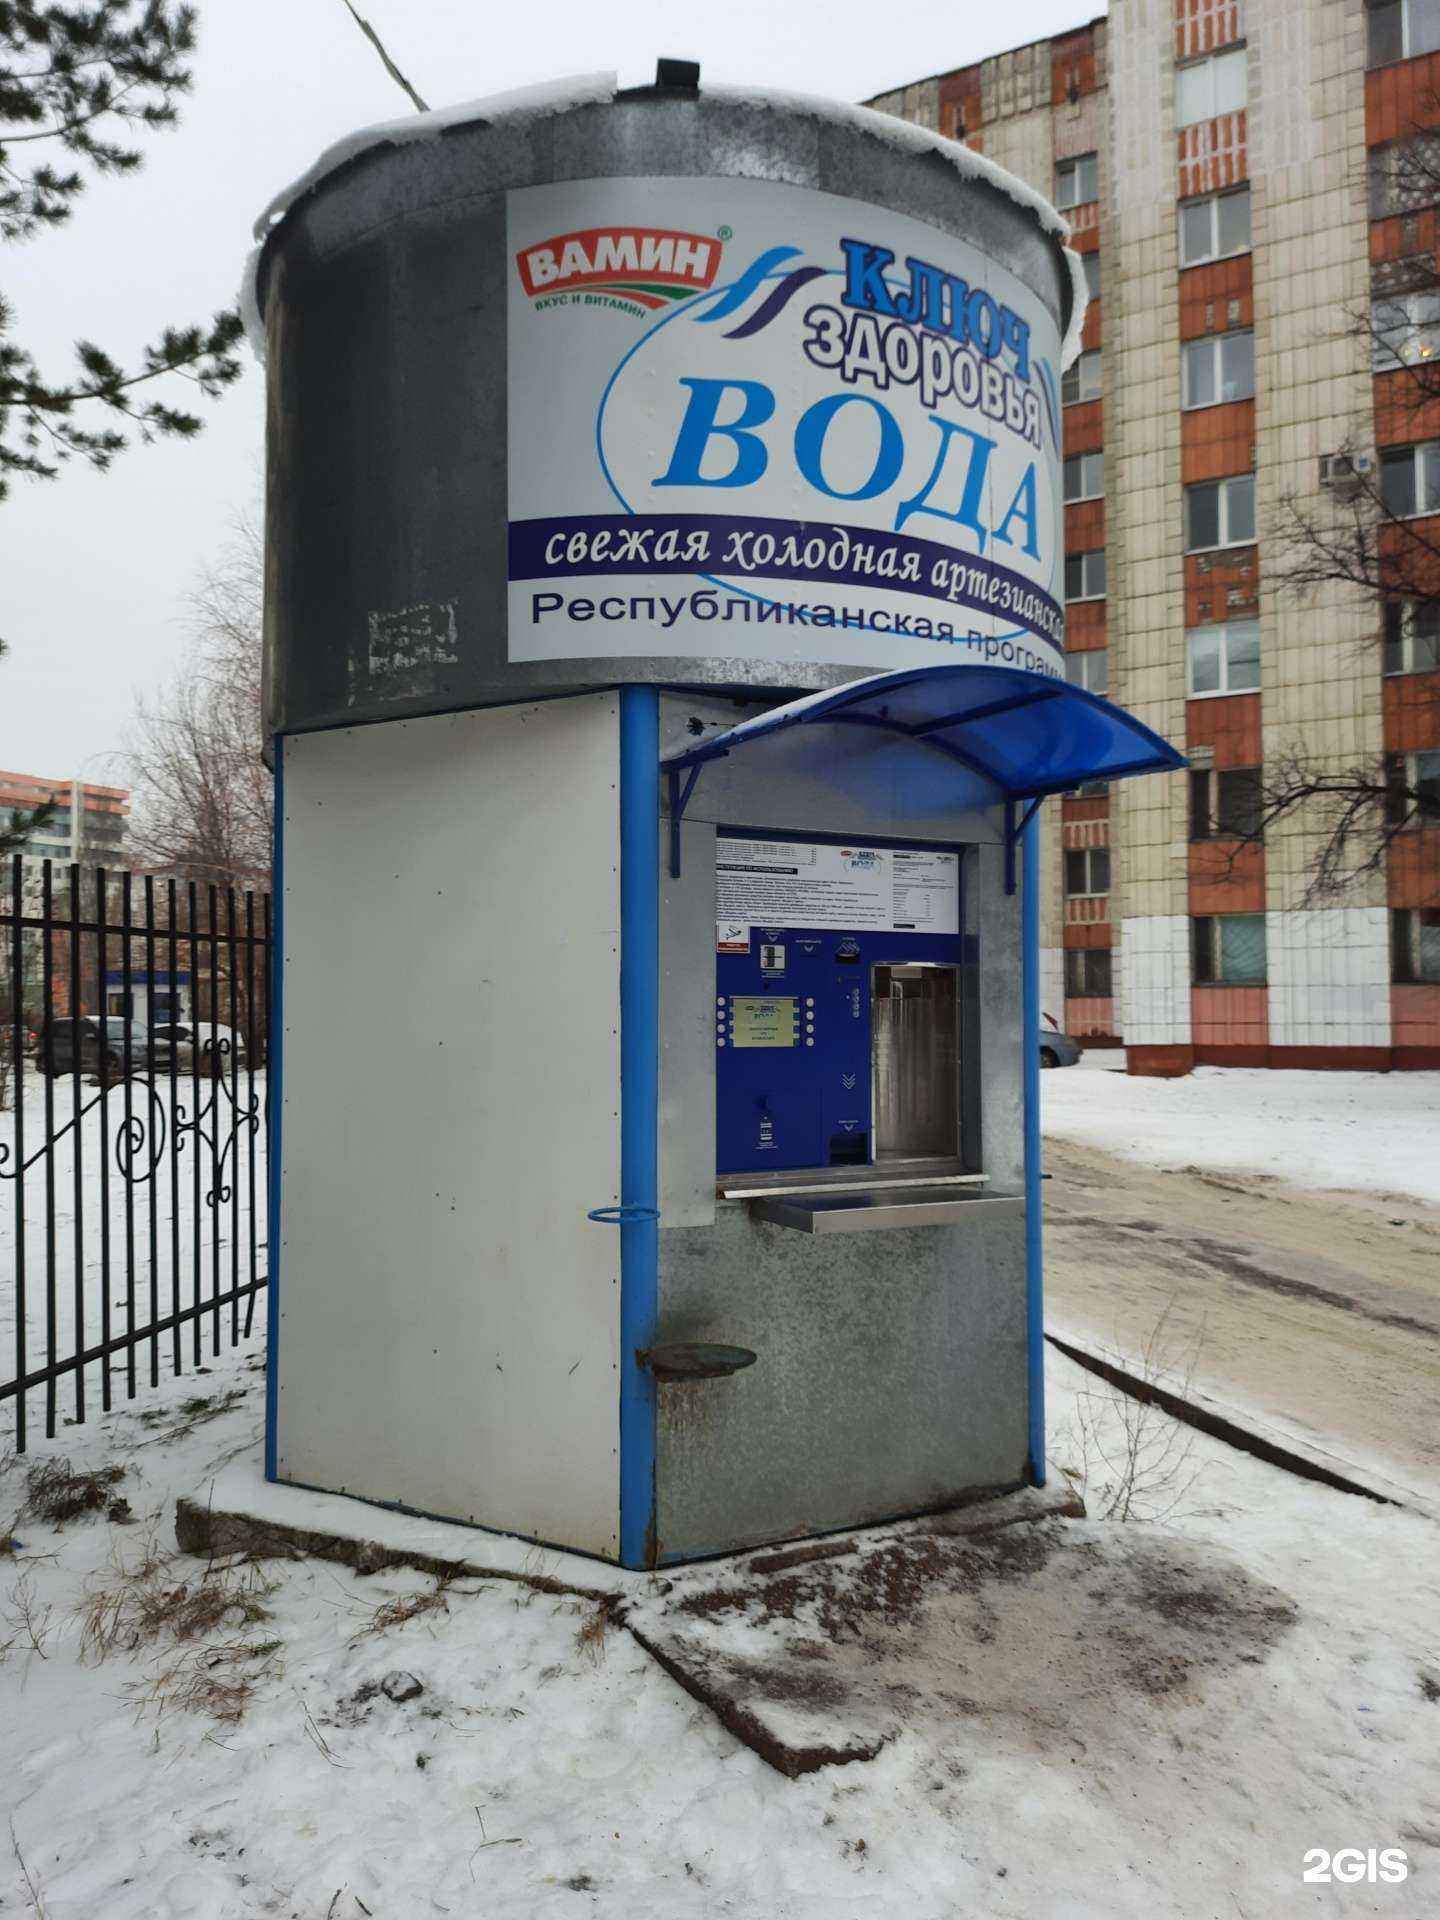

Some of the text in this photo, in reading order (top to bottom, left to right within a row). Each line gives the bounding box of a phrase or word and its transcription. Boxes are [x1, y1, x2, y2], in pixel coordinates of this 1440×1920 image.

[526, 235, 711, 288] ВАМИН
[534, 294, 646, 319] ВКУС И ВИТАМИН
[840, 237, 1030, 383] КЛЮЧ
[651, 377, 1041, 561] ВОДА
[545, 528, 710, 565] свежая
[723, 527, 921, 583] холодная
[532, 590, 954, 645] Республиканская
